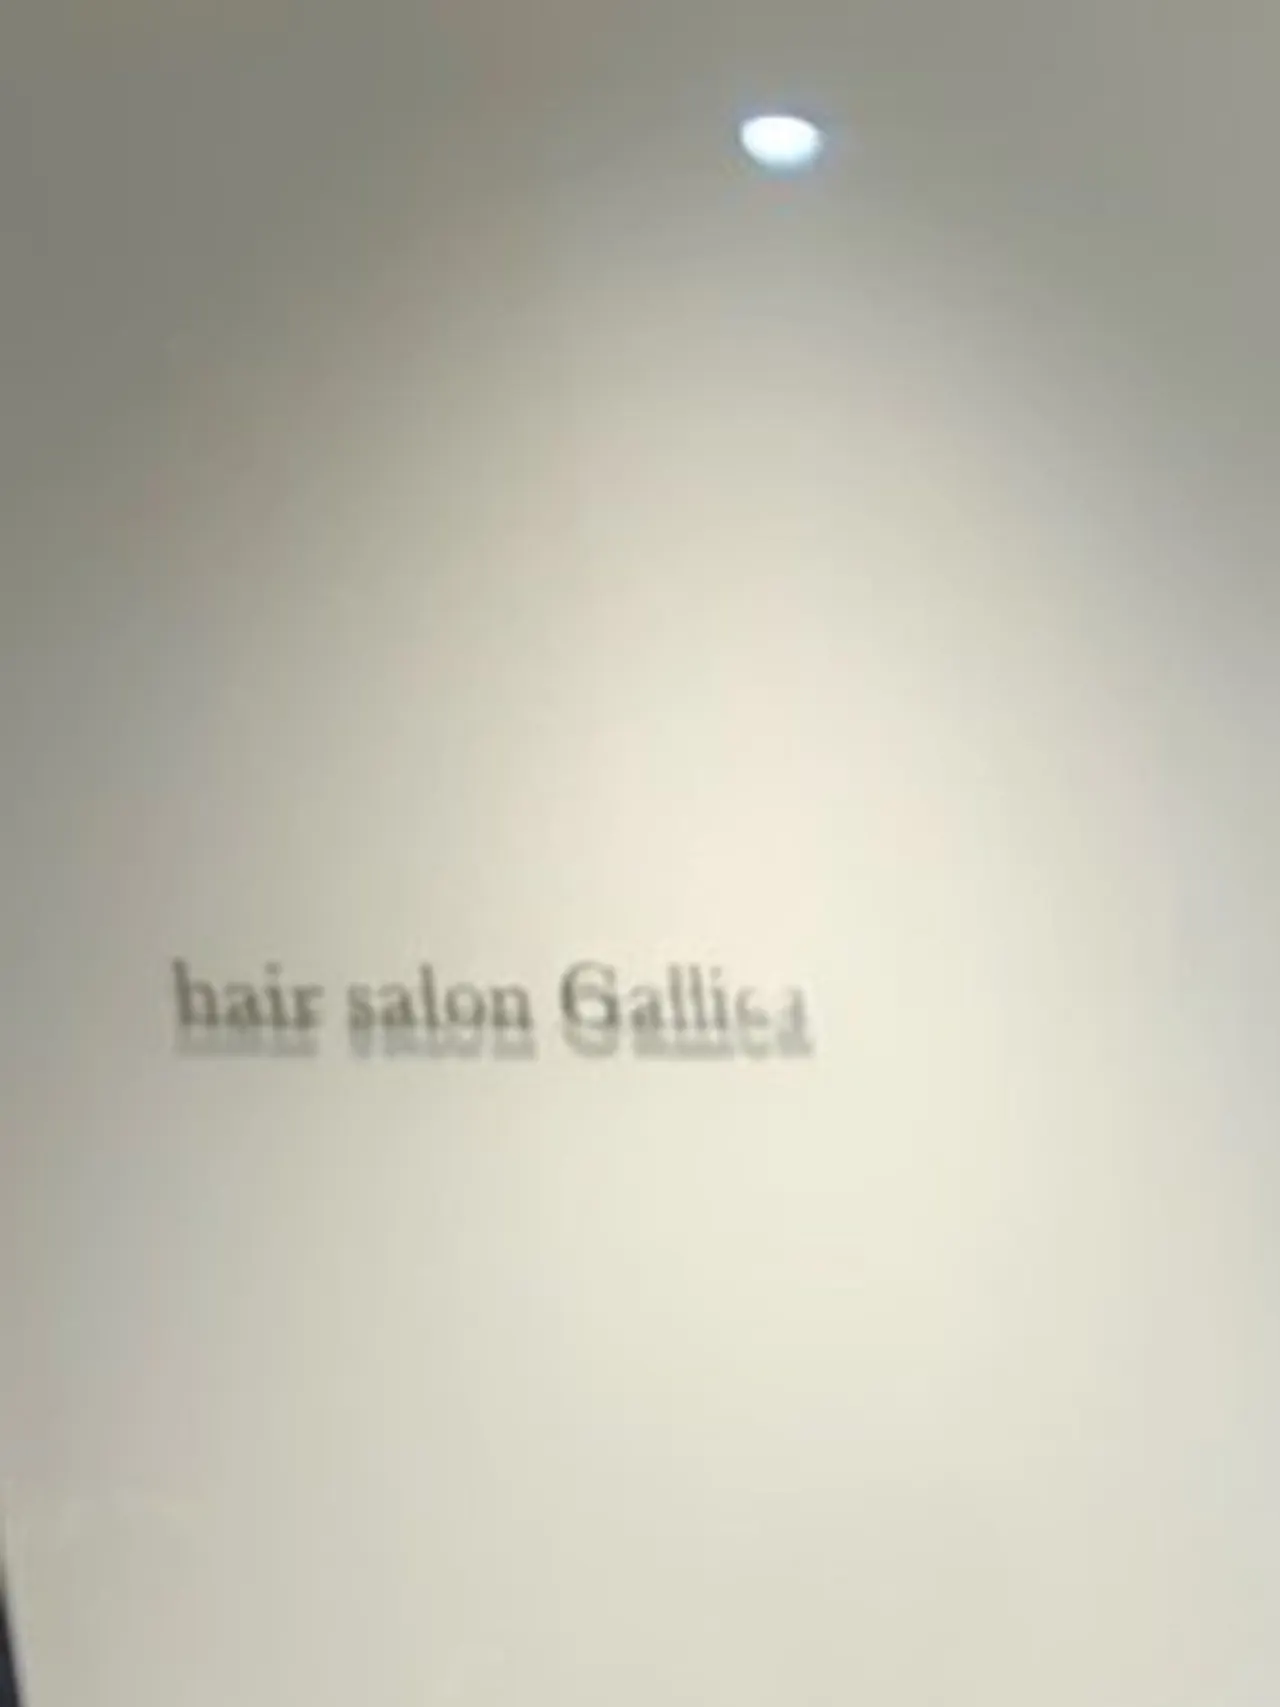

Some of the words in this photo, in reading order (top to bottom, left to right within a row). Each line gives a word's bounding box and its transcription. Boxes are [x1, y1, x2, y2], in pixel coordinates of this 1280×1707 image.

[172, 957, 325, 1030] hair
[346, 960, 536, 1032] salon
[558, 959, 814, 1034] Gallica
